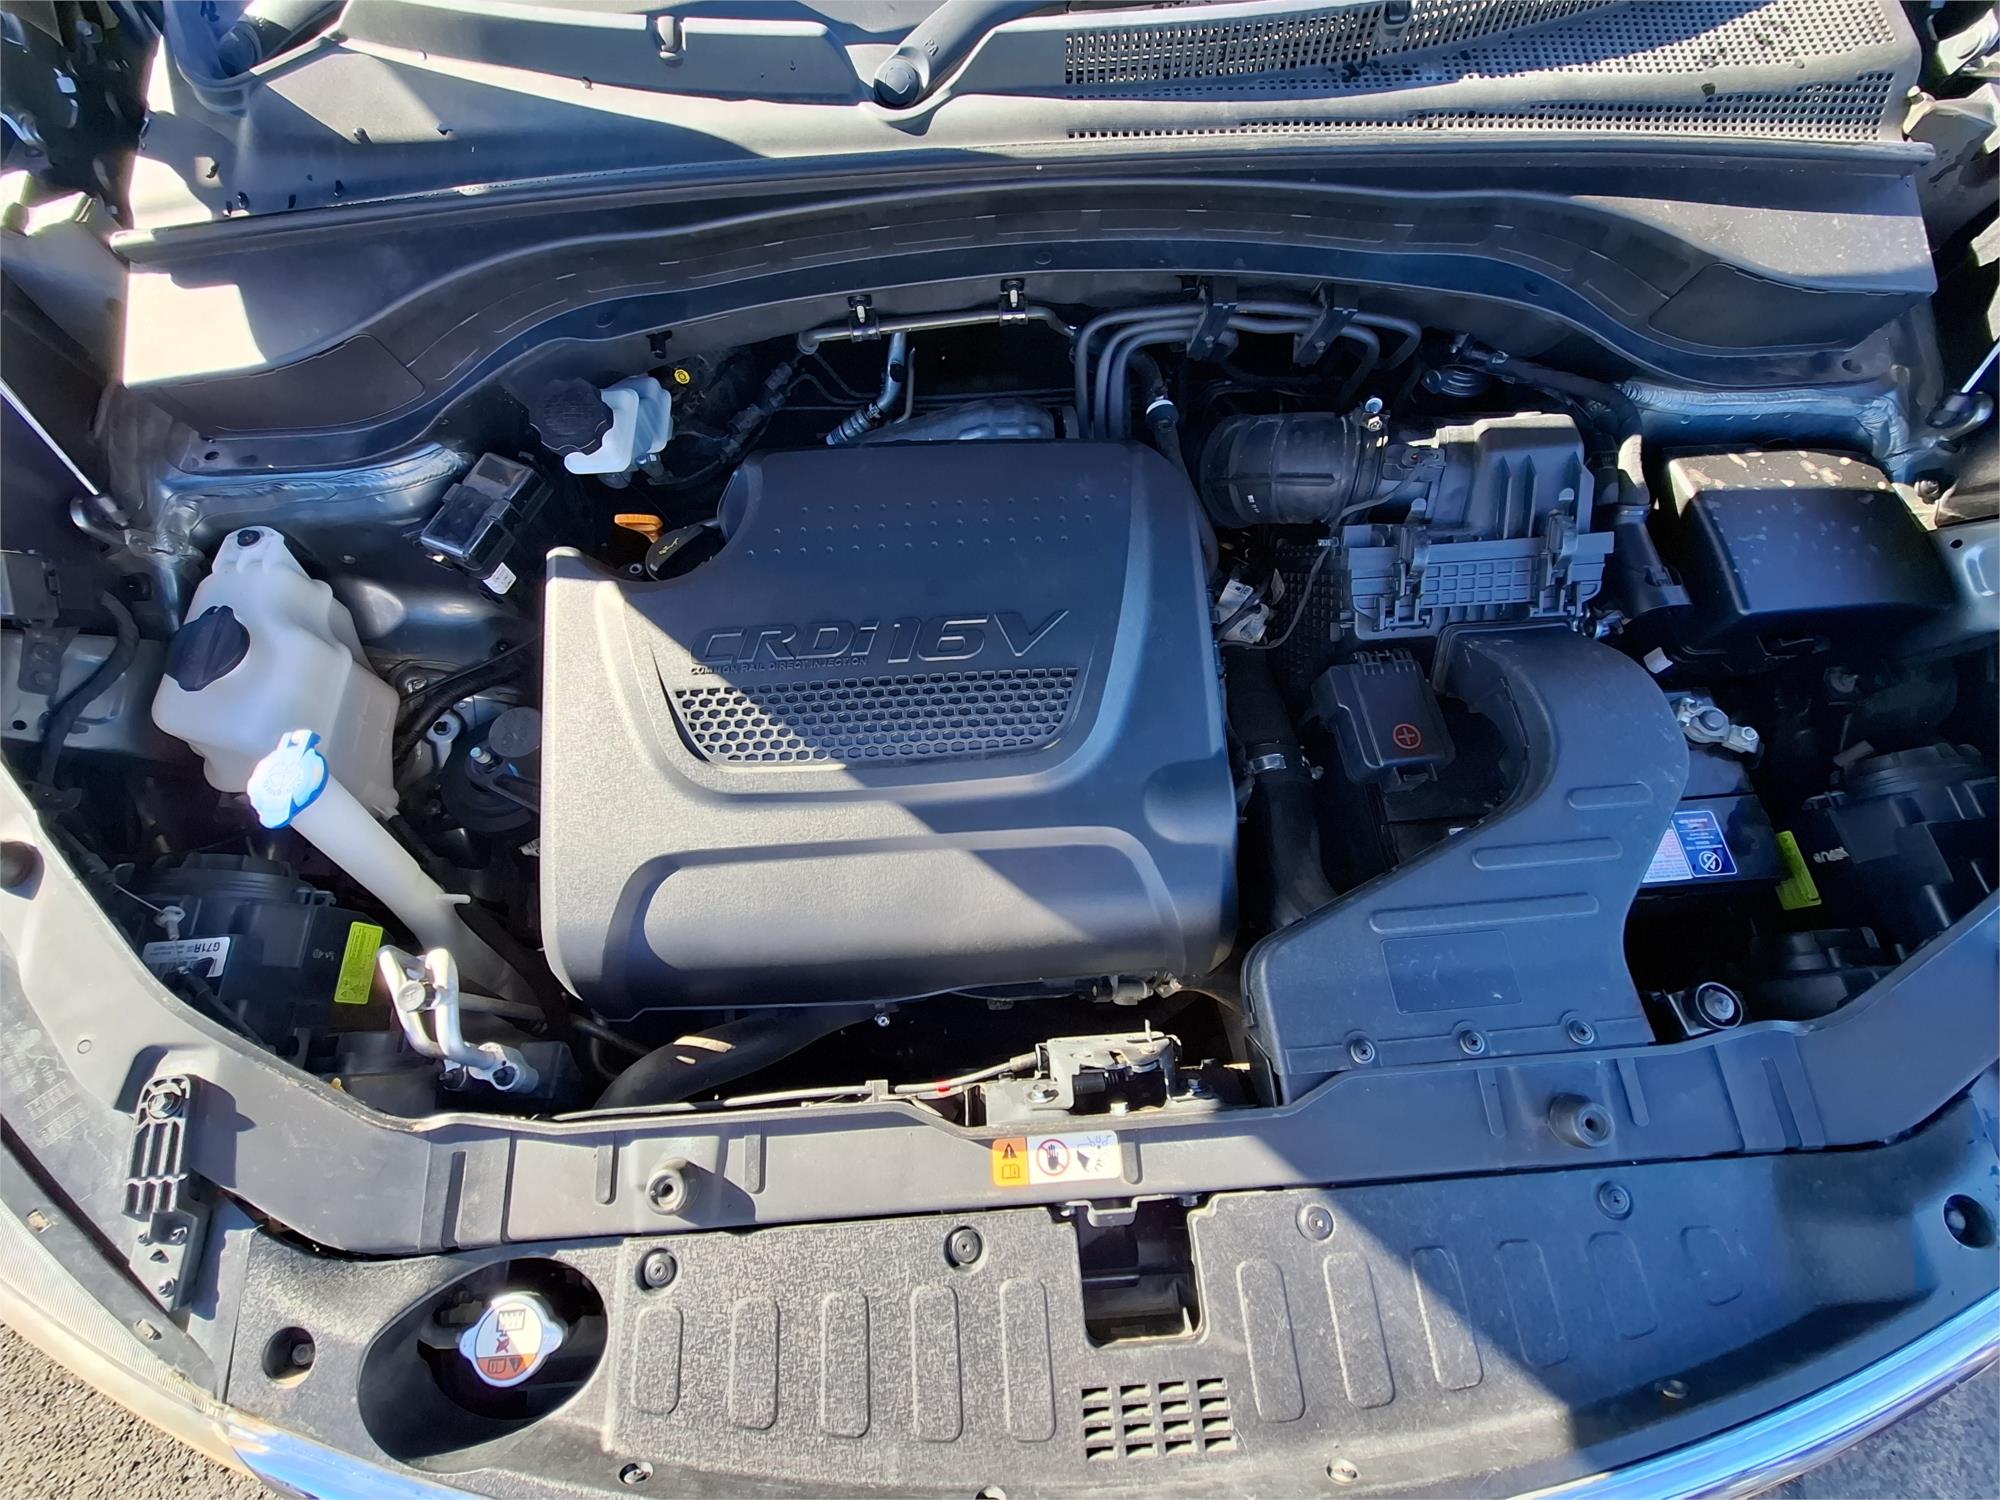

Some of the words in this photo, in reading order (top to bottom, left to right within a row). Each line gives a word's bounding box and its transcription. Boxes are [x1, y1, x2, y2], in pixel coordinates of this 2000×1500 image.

[690, 621, 880, 663] CRDi
[887, 609, 1070, 663] 16V
[690, 664, 737, 675] COMMON
[742, 663, 767, 674] RAIL
[768, 660, 806, 672] DIRECT
[810, 657, 868, 669] INJECTION
[194, 941, 221, 953] G71R
